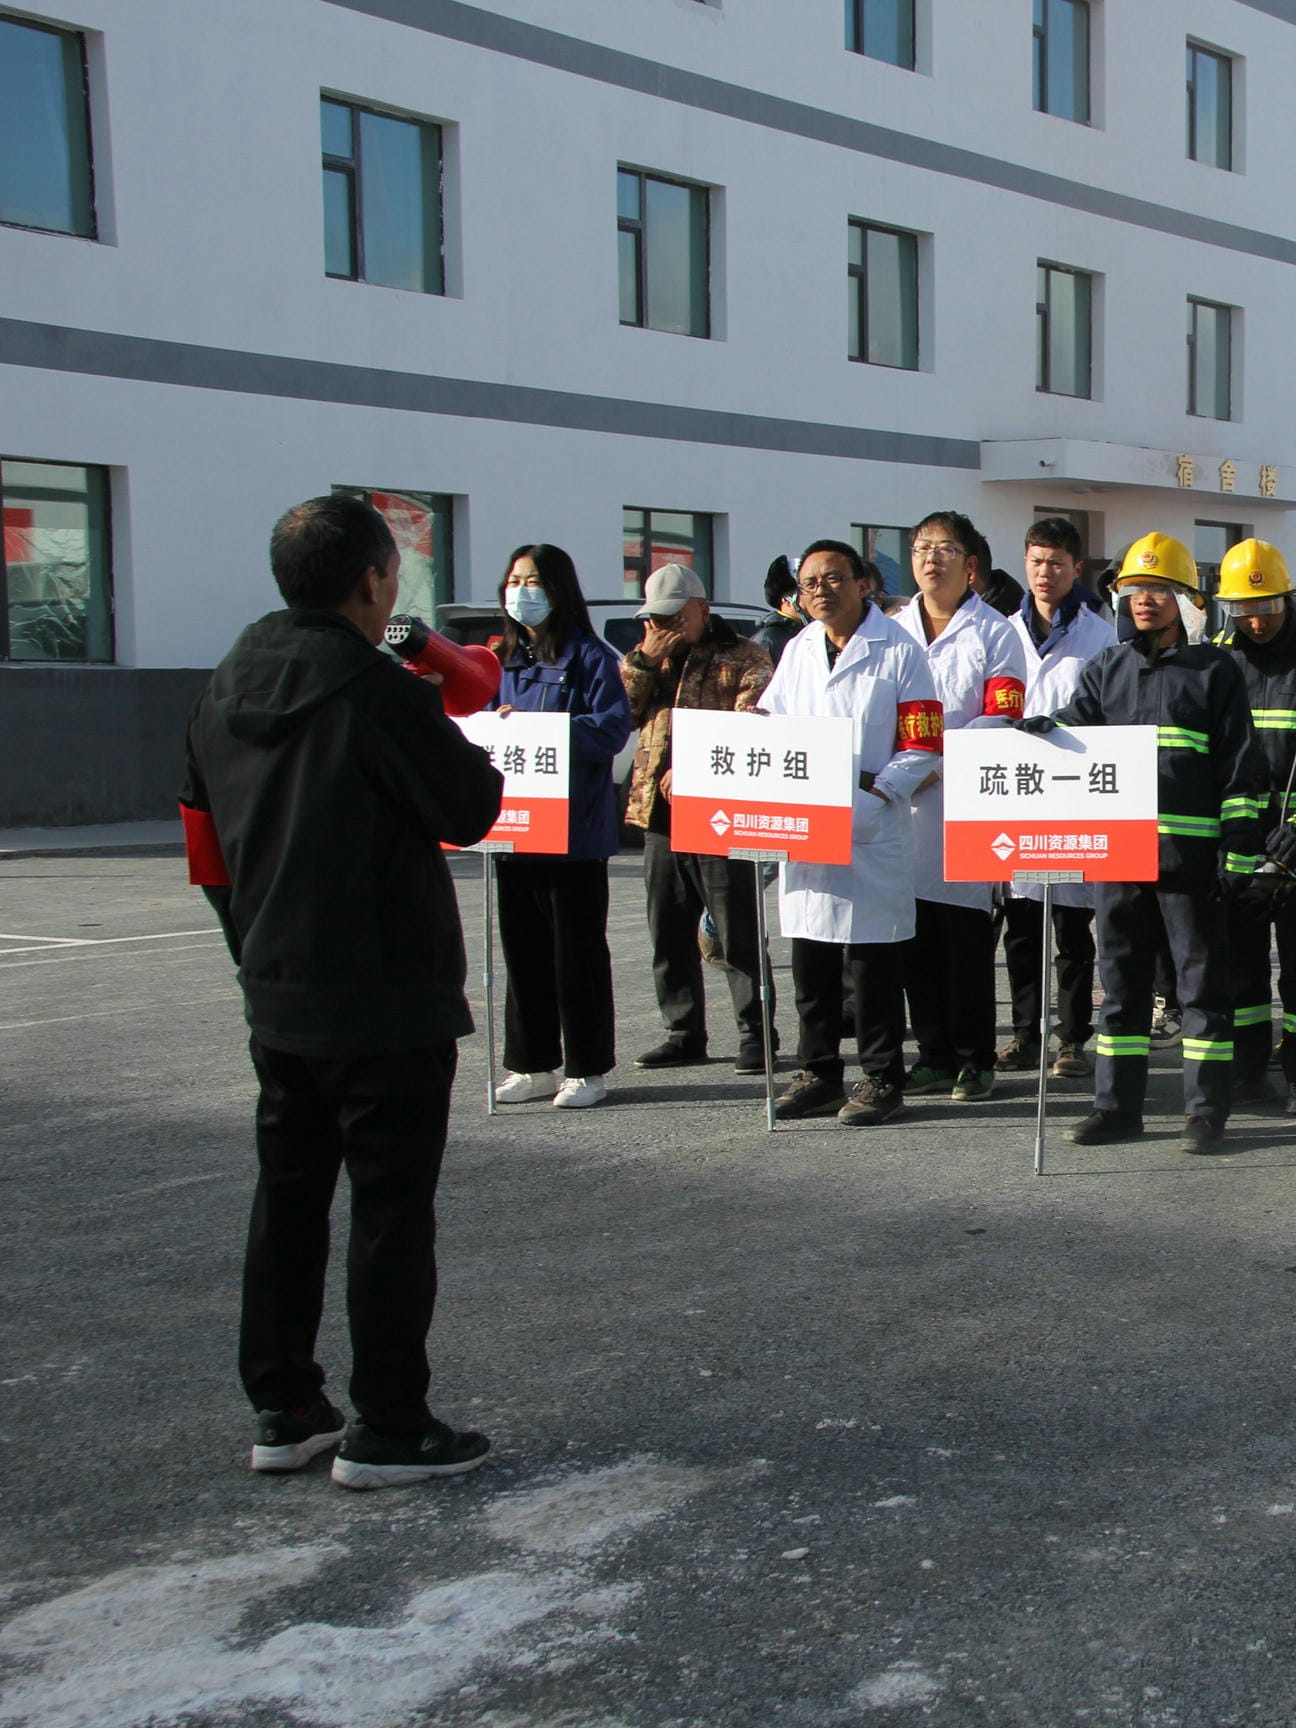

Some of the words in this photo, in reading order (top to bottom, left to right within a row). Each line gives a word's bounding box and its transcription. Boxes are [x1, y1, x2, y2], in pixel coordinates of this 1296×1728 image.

[1176, 453, 1277, 496] 宿舍楼
[711, 745, 809, 780] 救护组
[979, 762, 1119, 796] 疏散一组
[496, 810, 530, 824] 源集团
[733, 813, 809, 833] 四川资源集团
[1018, 834, 1109, 851] 四川资源集团
[1019, 852, 1047, 860] SICHUAN
[1048, 852, 1084, 860] RESOURCES
[1085, 852, 1109, 860] GROUP
